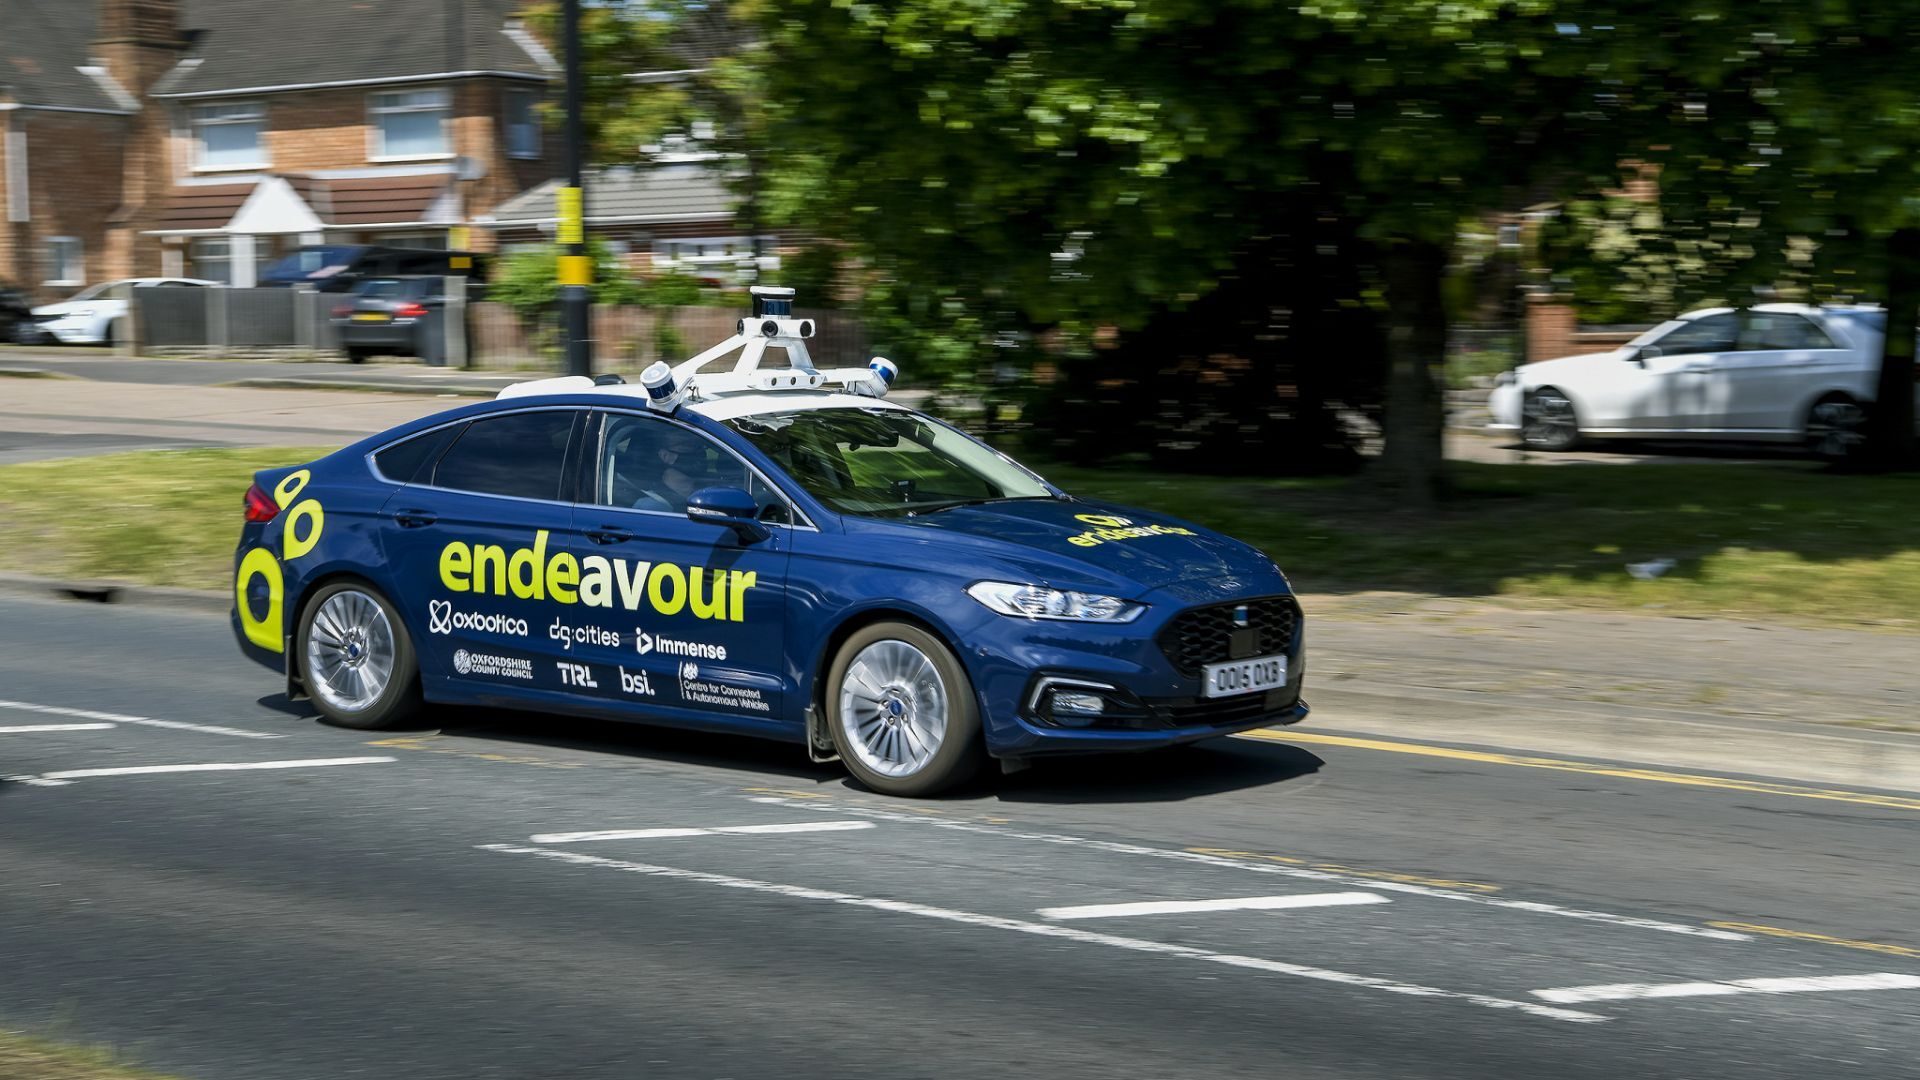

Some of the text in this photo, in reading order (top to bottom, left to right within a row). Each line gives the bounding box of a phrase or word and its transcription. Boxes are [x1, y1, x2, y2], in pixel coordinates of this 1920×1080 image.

[439, 529, 757, 622] endeavour
[452, 611, 528, 637] oxbotica
[656, 634, 727, 661] Immense
[471, 653, 533, 671] OXFORDSHIRE
[471, 664, 534, 680] COUNTY COUNCIL
[556, 661, 598, 689] TRL
[1253, 660, 1279, 686] OXB
[683, 680, 761, 700] Centre for Connected
[685, 690, 770, 712] & Autonomous Vehicles
